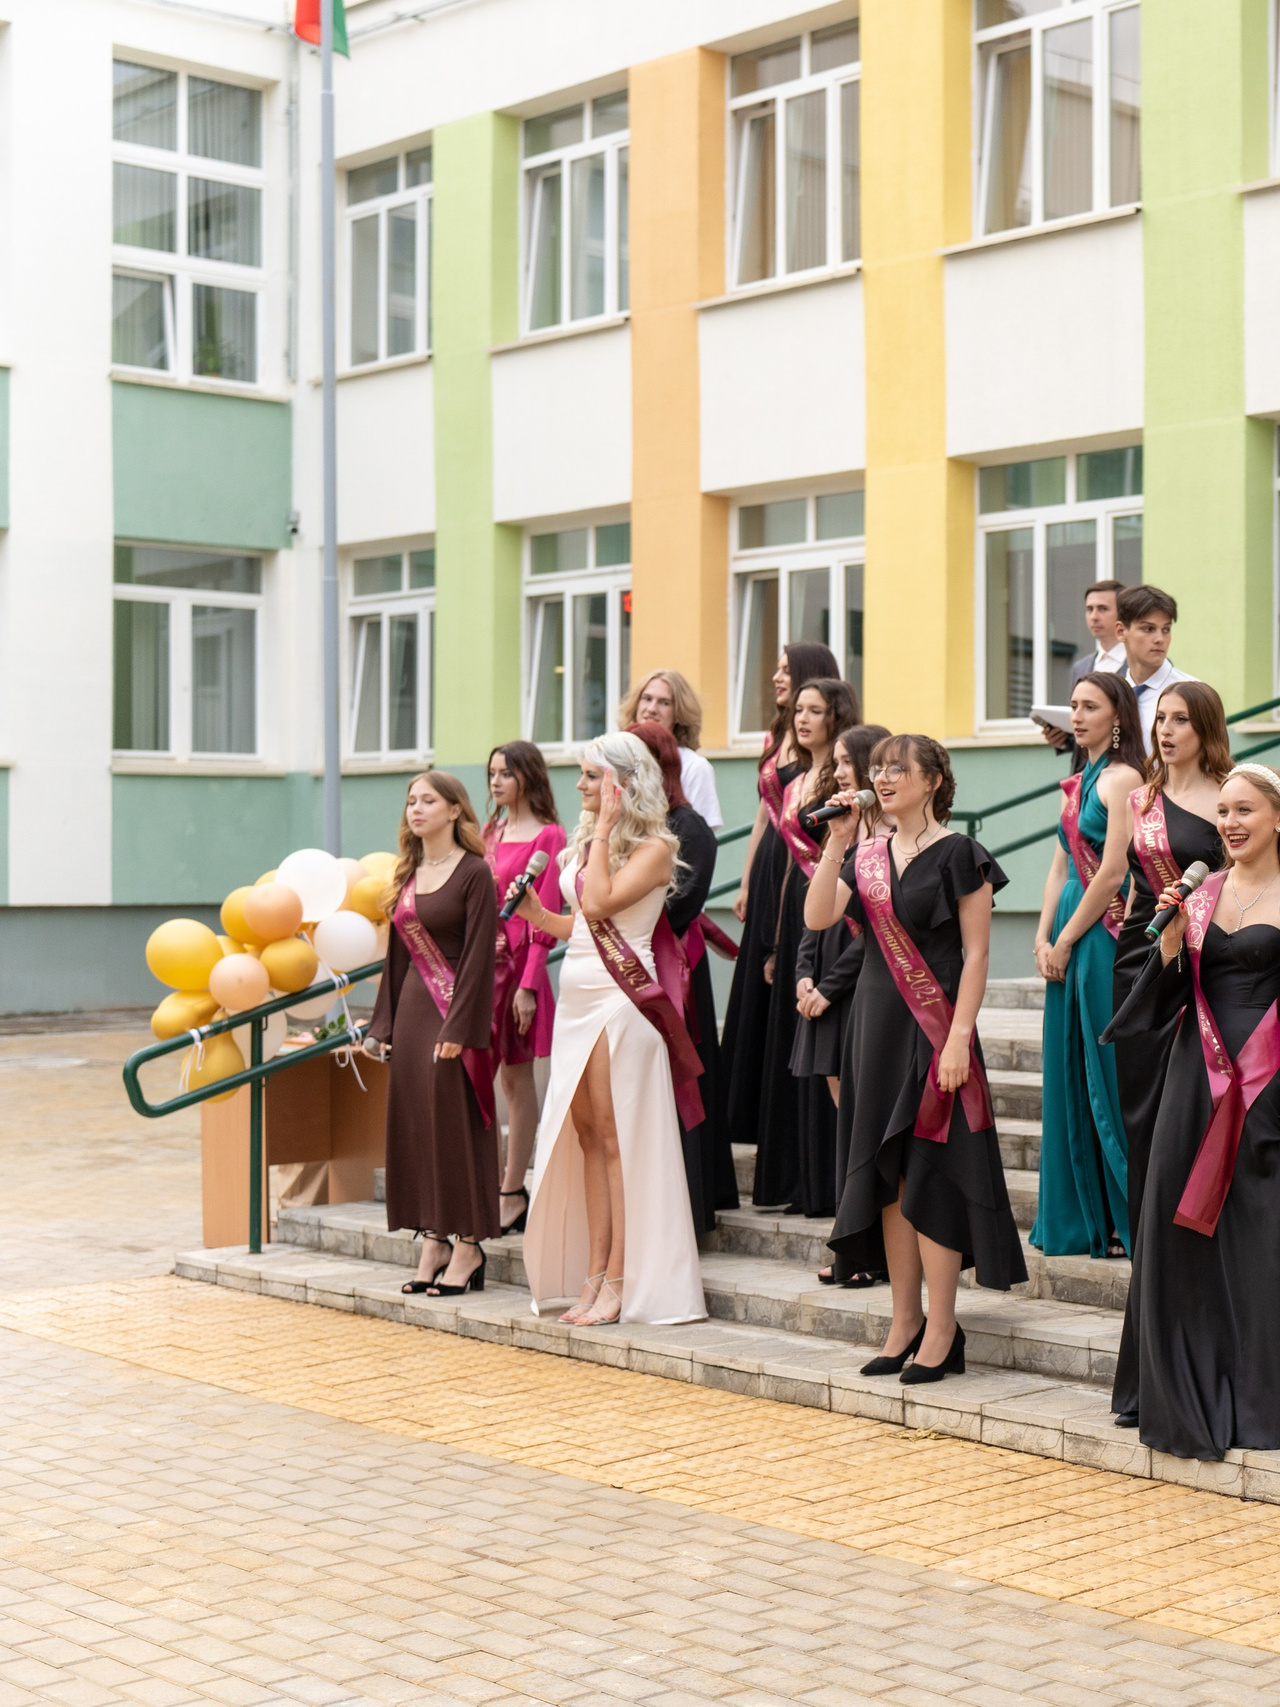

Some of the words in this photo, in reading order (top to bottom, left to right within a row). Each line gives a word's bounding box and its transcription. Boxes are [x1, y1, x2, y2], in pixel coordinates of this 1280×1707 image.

[1141, 806, 1174, 888] Выпускни
[617, 958, 652, 993] 2024
[866, 880, 914, 974] Выпускница
[904, 969, 942, 1007] 2024
